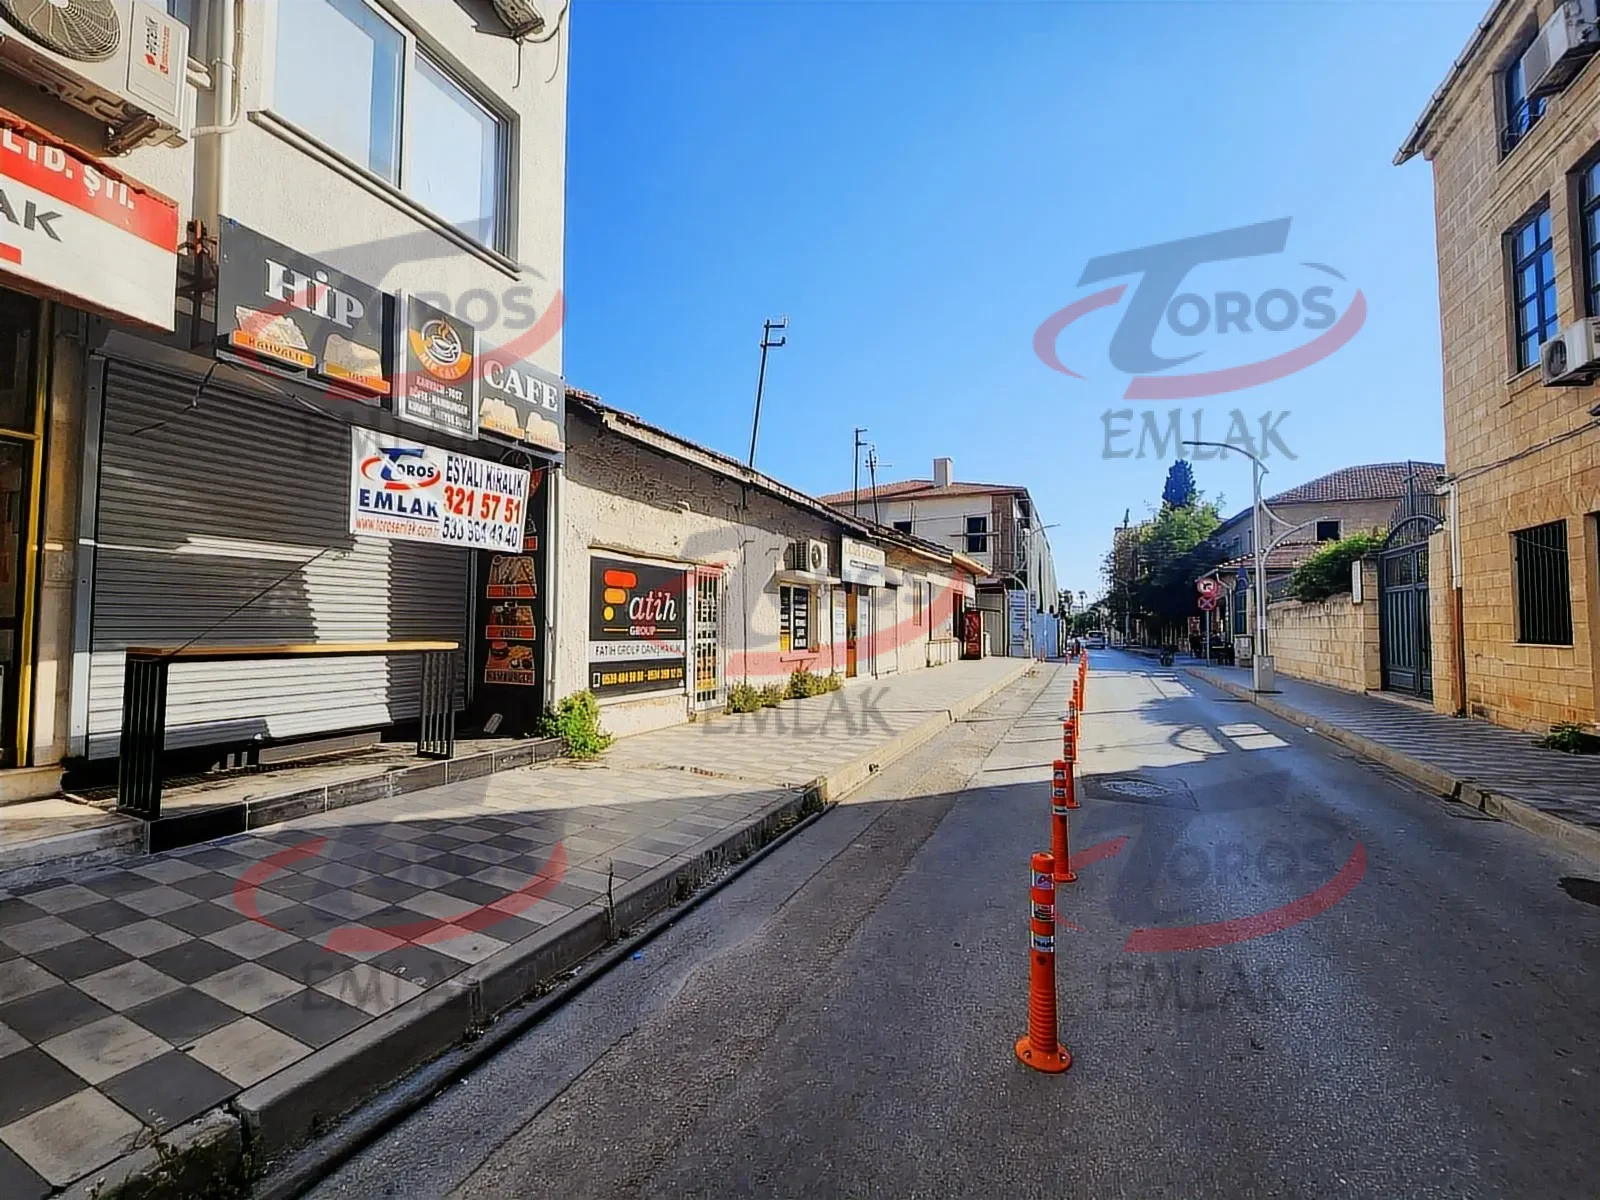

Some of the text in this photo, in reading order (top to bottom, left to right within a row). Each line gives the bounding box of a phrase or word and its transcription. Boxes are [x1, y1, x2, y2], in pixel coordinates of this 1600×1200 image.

[483, 360, 558, 413] CAFE
[359, 488, 439, 518] EMLAK
[444, 485, 521, 524] 321 57 51
[629, 626, 656, 636] GROUP
